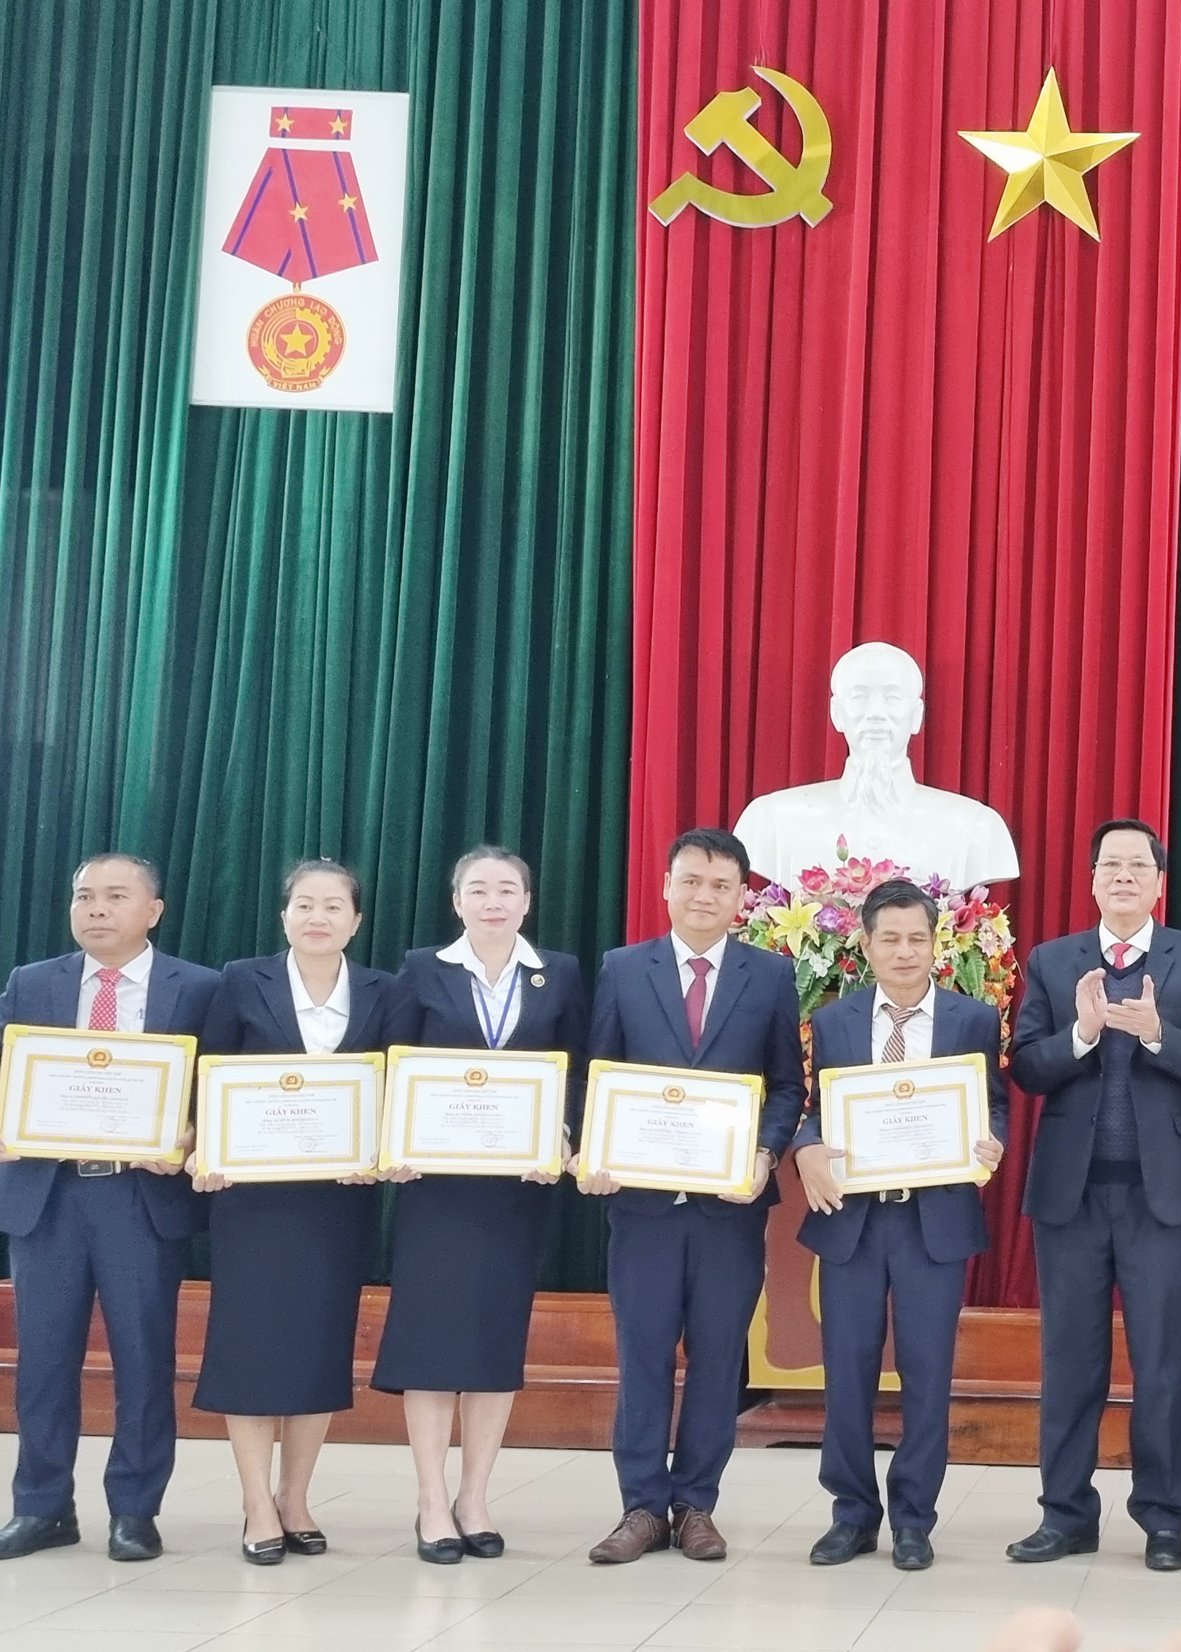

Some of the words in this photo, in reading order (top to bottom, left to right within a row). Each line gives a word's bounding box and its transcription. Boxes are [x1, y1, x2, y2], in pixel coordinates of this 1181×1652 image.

[310, 301, 327, 316] LAO
[296, 382, 316, 390] NAM
[905, 1114, 928, 1123] KHEN
